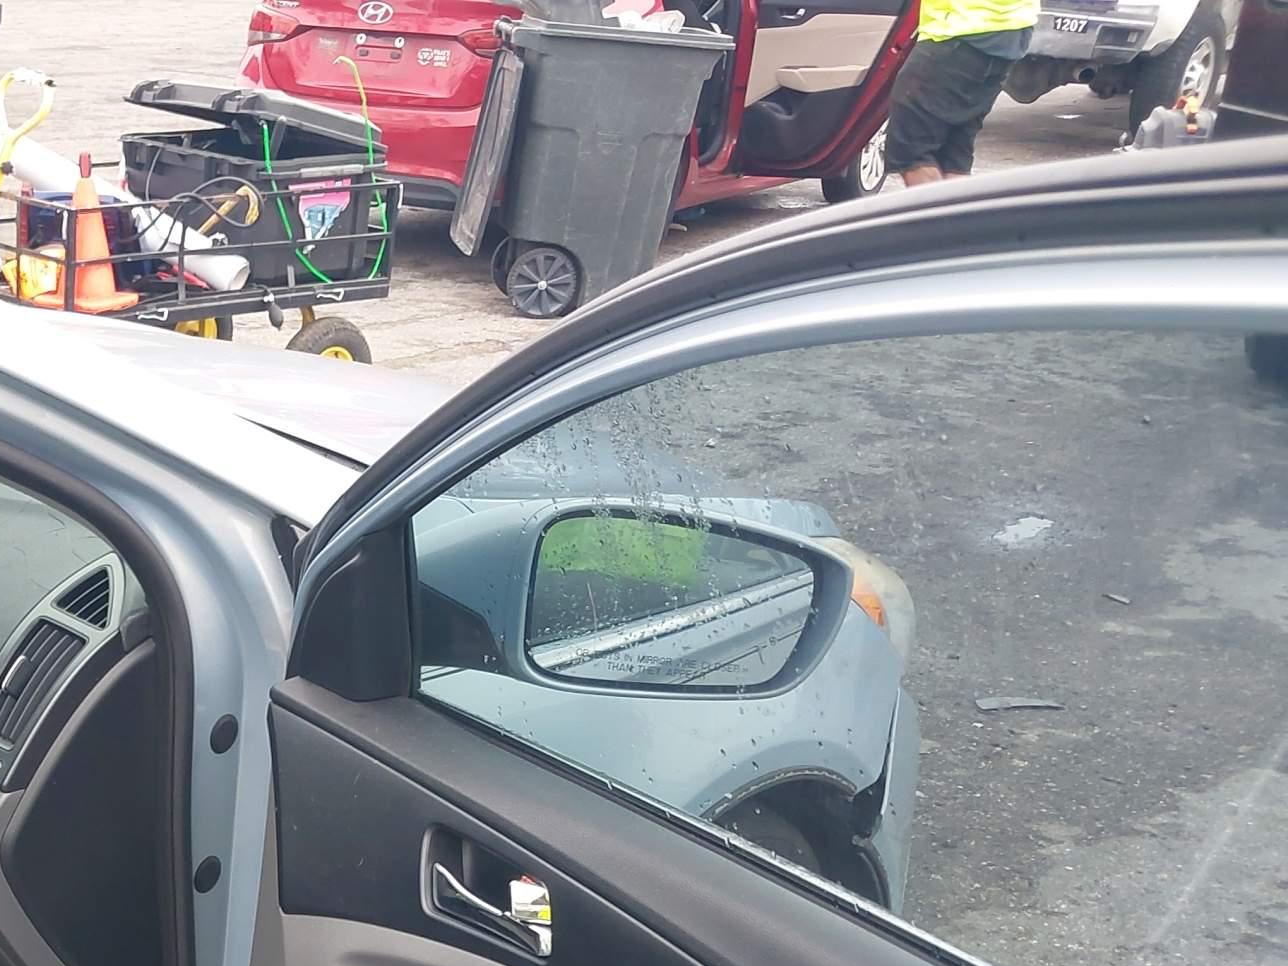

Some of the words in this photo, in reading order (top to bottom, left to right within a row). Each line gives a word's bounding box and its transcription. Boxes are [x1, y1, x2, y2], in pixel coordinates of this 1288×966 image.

[1055, 17, 1088, 33] 1207
[638, 655, 672, 666] MIRROR
[607, 661, 634, 673] THAN
